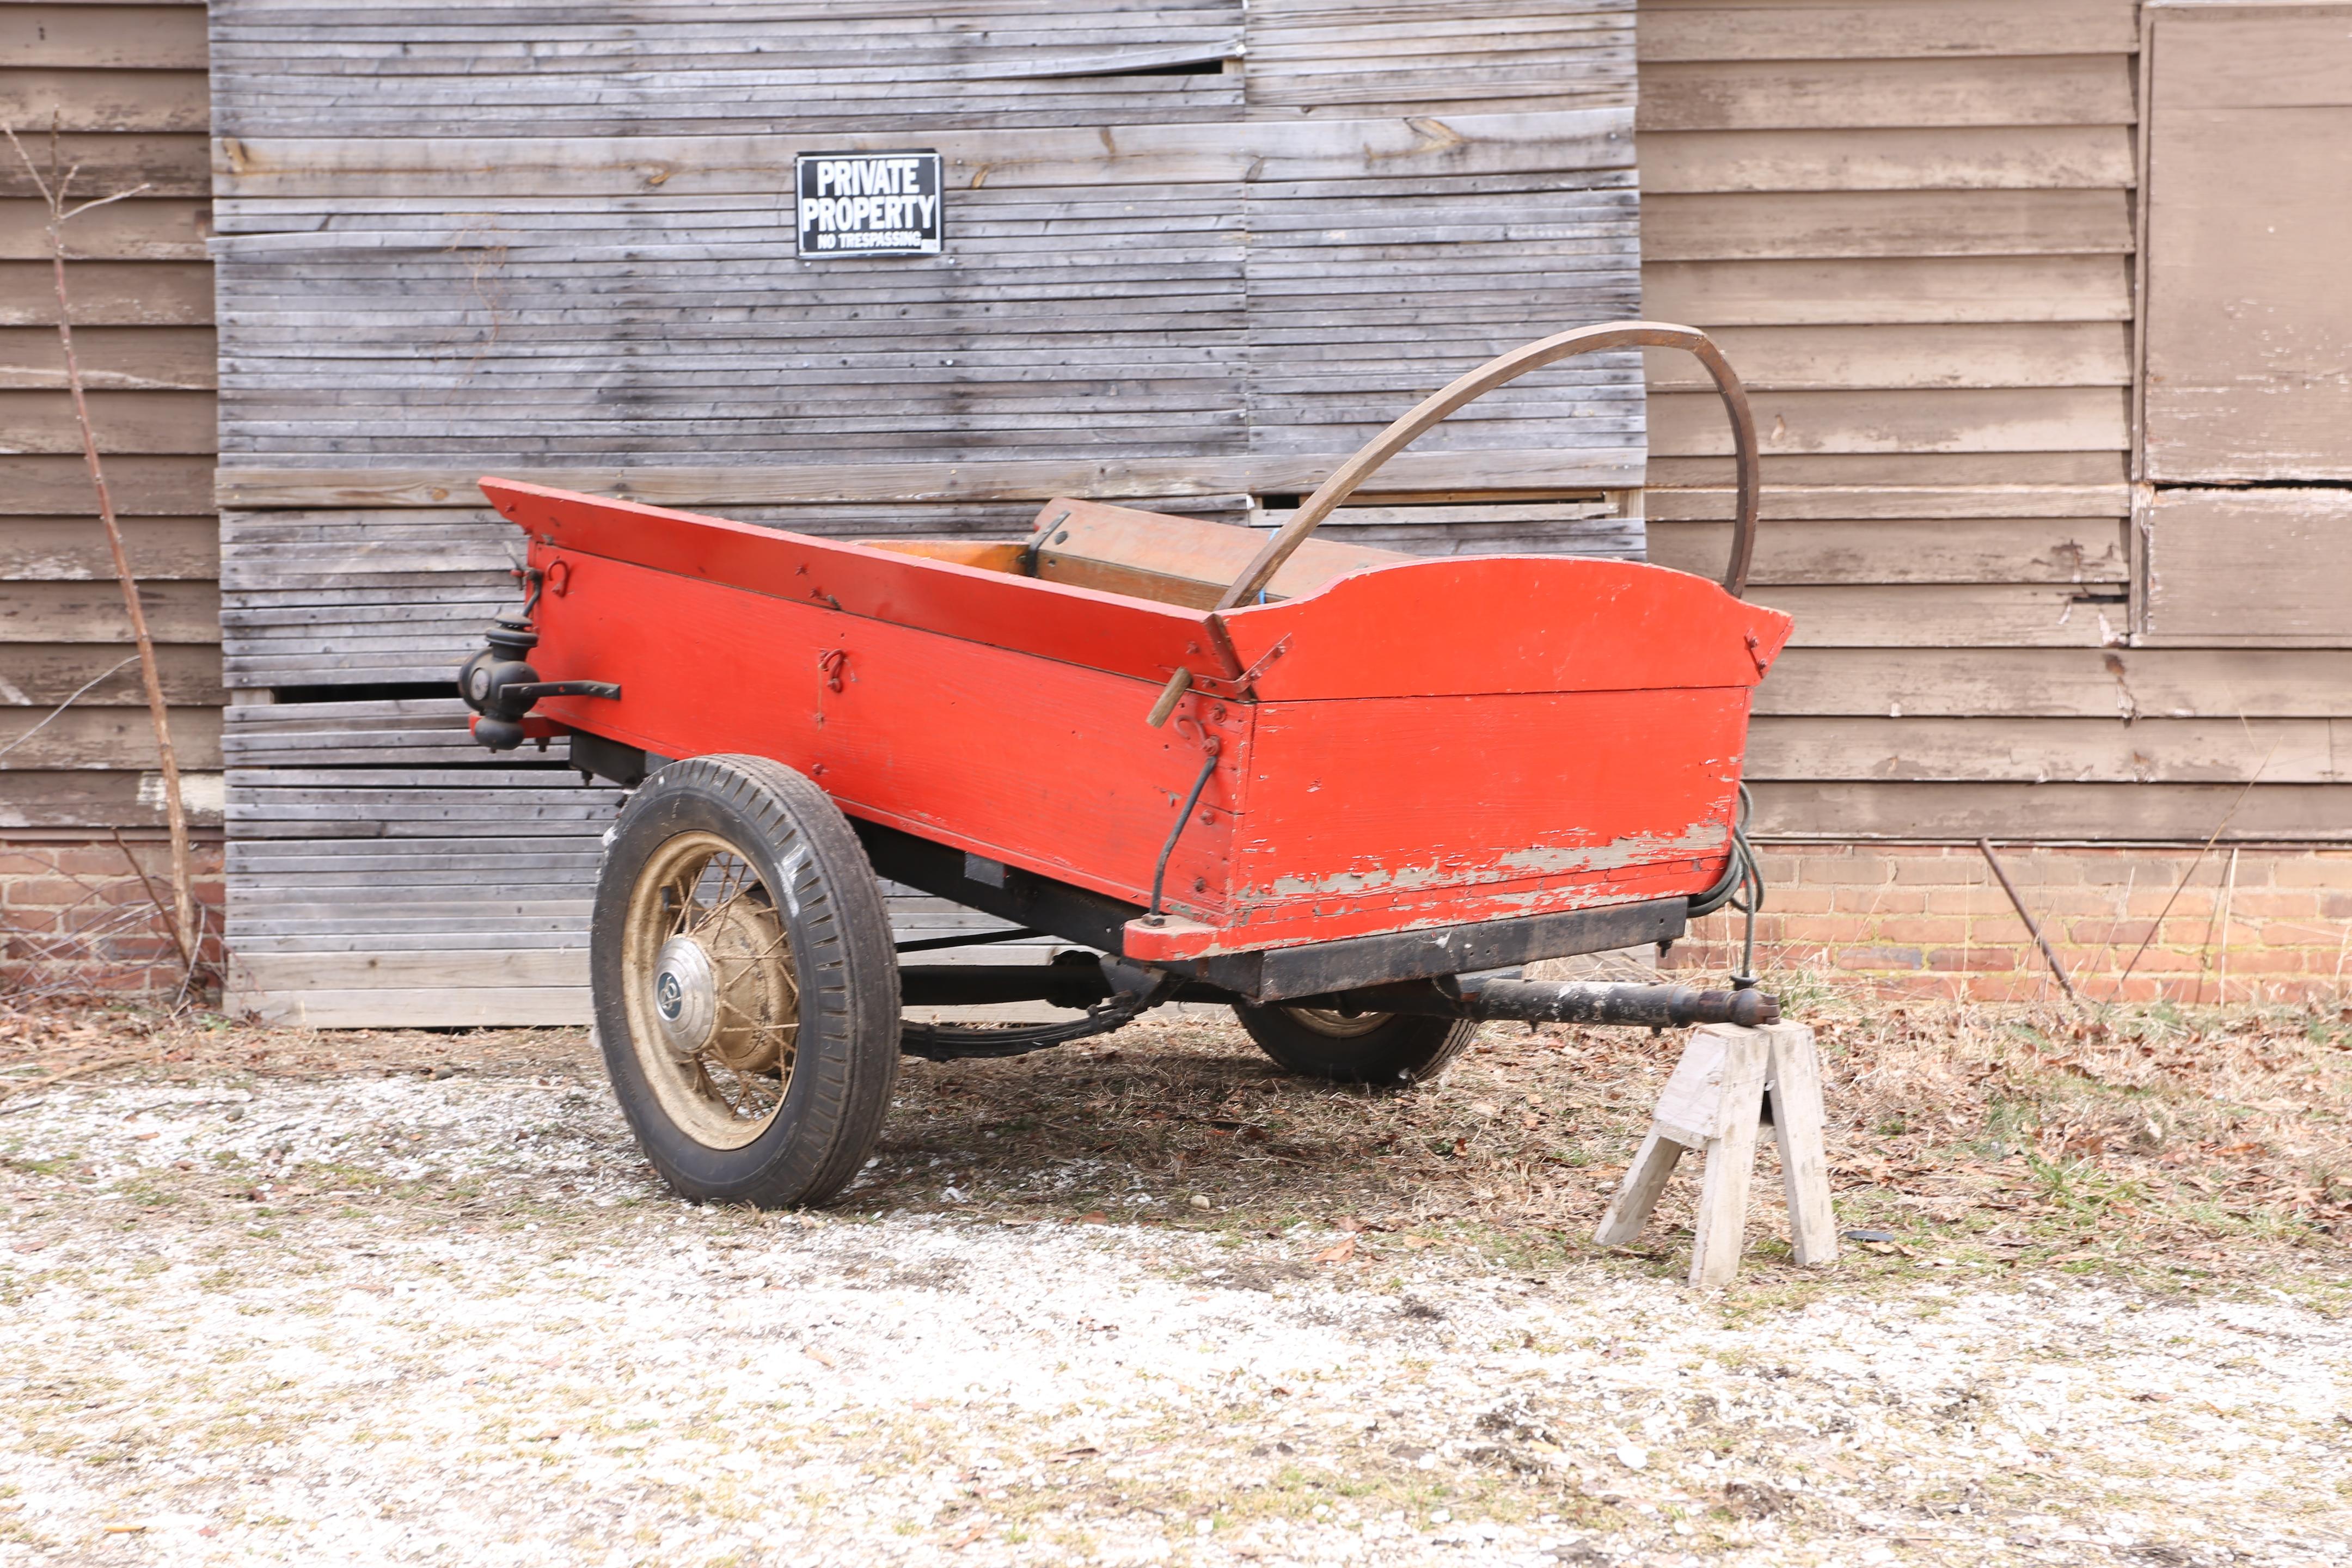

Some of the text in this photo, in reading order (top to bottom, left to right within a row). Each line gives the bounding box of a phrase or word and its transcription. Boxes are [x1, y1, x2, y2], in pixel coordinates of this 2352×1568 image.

[817, 160, 920, 197] PRIVATE
[803, 195, 935, 232] PROPERTY
[817, 231, 922, 249] NO TRESPASSING
